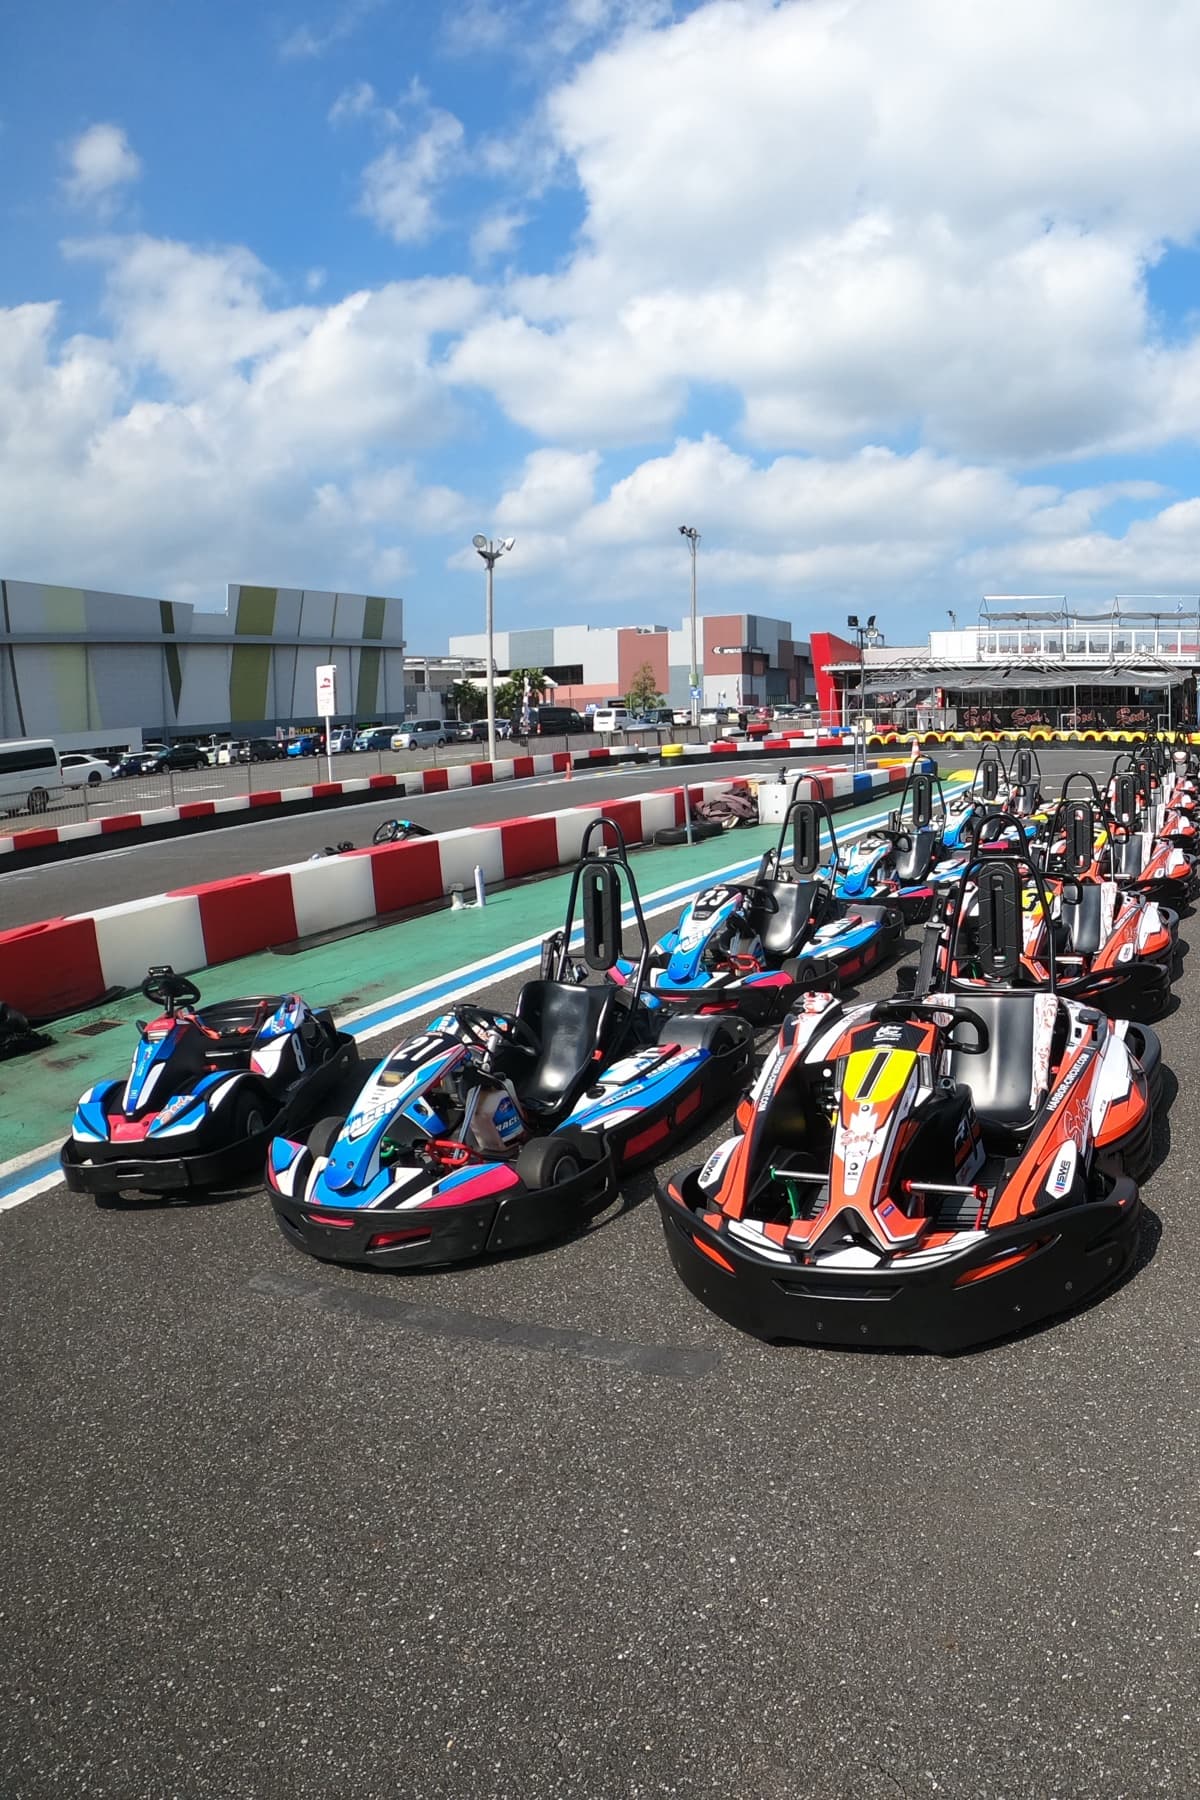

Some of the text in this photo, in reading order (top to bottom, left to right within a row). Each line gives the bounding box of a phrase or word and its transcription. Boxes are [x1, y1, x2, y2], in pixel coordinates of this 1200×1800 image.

[695, 890, 729, 907] 23
[292, 1033, 306, 1072] 8
[392, 1036, 445, 1062] 21
[853, 1050, 894, 1101] 1
[1046, 1053, 1090, 1112] HARBOR-CIRCUIT.COM
